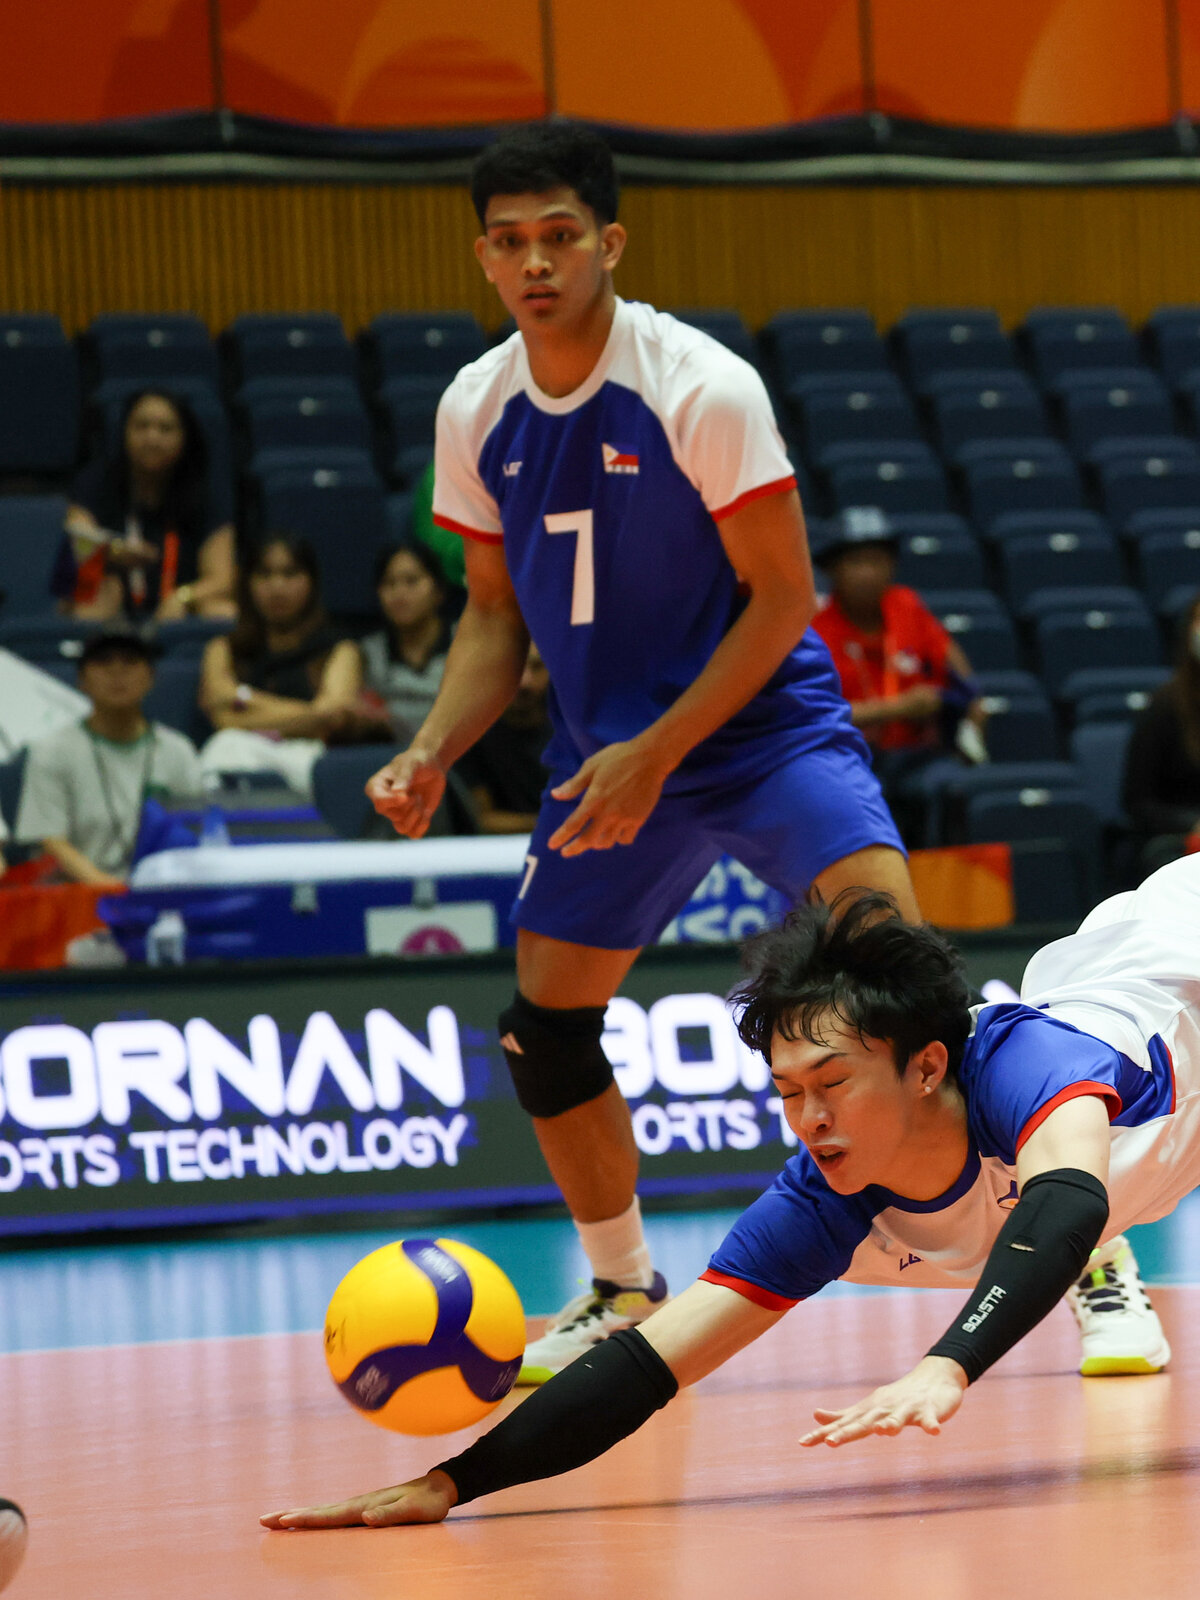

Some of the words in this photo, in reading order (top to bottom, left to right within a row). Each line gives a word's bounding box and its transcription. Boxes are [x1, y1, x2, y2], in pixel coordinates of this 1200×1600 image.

[543, 509, 594, 626] 7
[518, 854, 538, 900] 7
[0, 1005, 466, 1130] ORNAN
[0, 1134, 120, 1193] ORTS
[128, 1113, 469, 1184] TECHNOLOGY
[632, 1098, 762, 1156] ORTS
[961, 1284, 1007, 1334] BOLISTA
